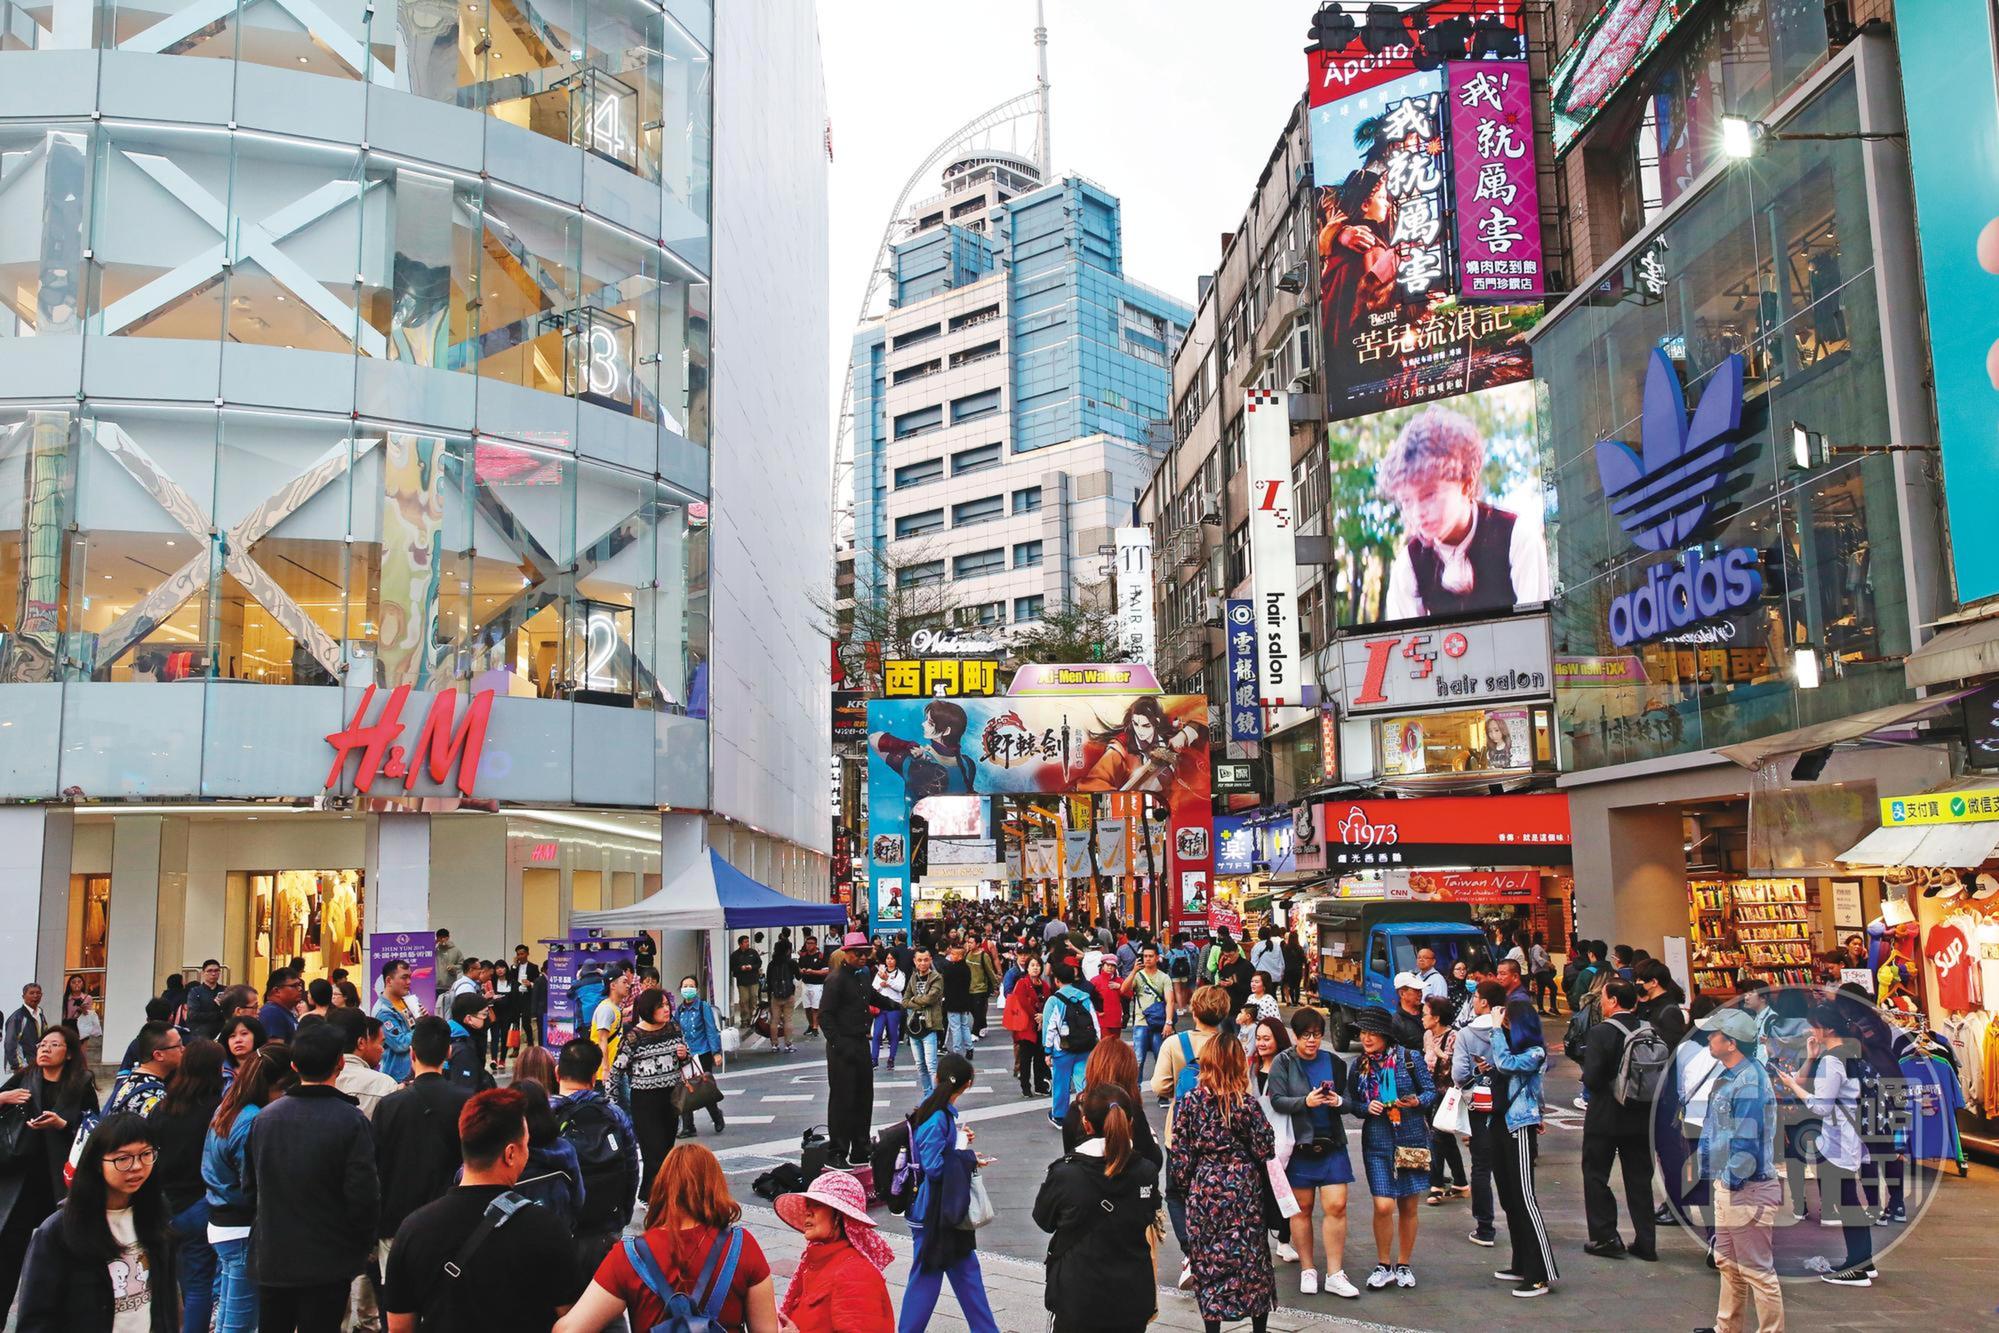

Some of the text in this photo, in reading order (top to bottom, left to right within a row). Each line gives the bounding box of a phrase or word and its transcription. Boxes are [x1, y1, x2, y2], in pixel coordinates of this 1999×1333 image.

[595, 93, 624, 158] 4
[1466, 259, 1537, 276] 燒肉吃到飽
[588, 325, 618, 395] 3
[1352, 305, 1513, 365] 苦兒流浪記
[1266, 592, 1286, 628] hair
[1607, 546, 1763, 647] adidas
[583, 615, 617, 688] 2
[885, 660, 998, 695] 西門町
[1085, 670, 1132, 685] Walker
[1268, 632, 1287, 685] salon
[1232, 631, 1260, 735] 雪龍眼鏡
[1437, 670, 1544, 696] hair salon
[325, 682, 495, 797] H&M
[980, 714, 1070, 776] 軒轅劍
[1907, 801, 1940, 818] 支付寶
[1443, 872, 1528, 889] Taiwan No.1
